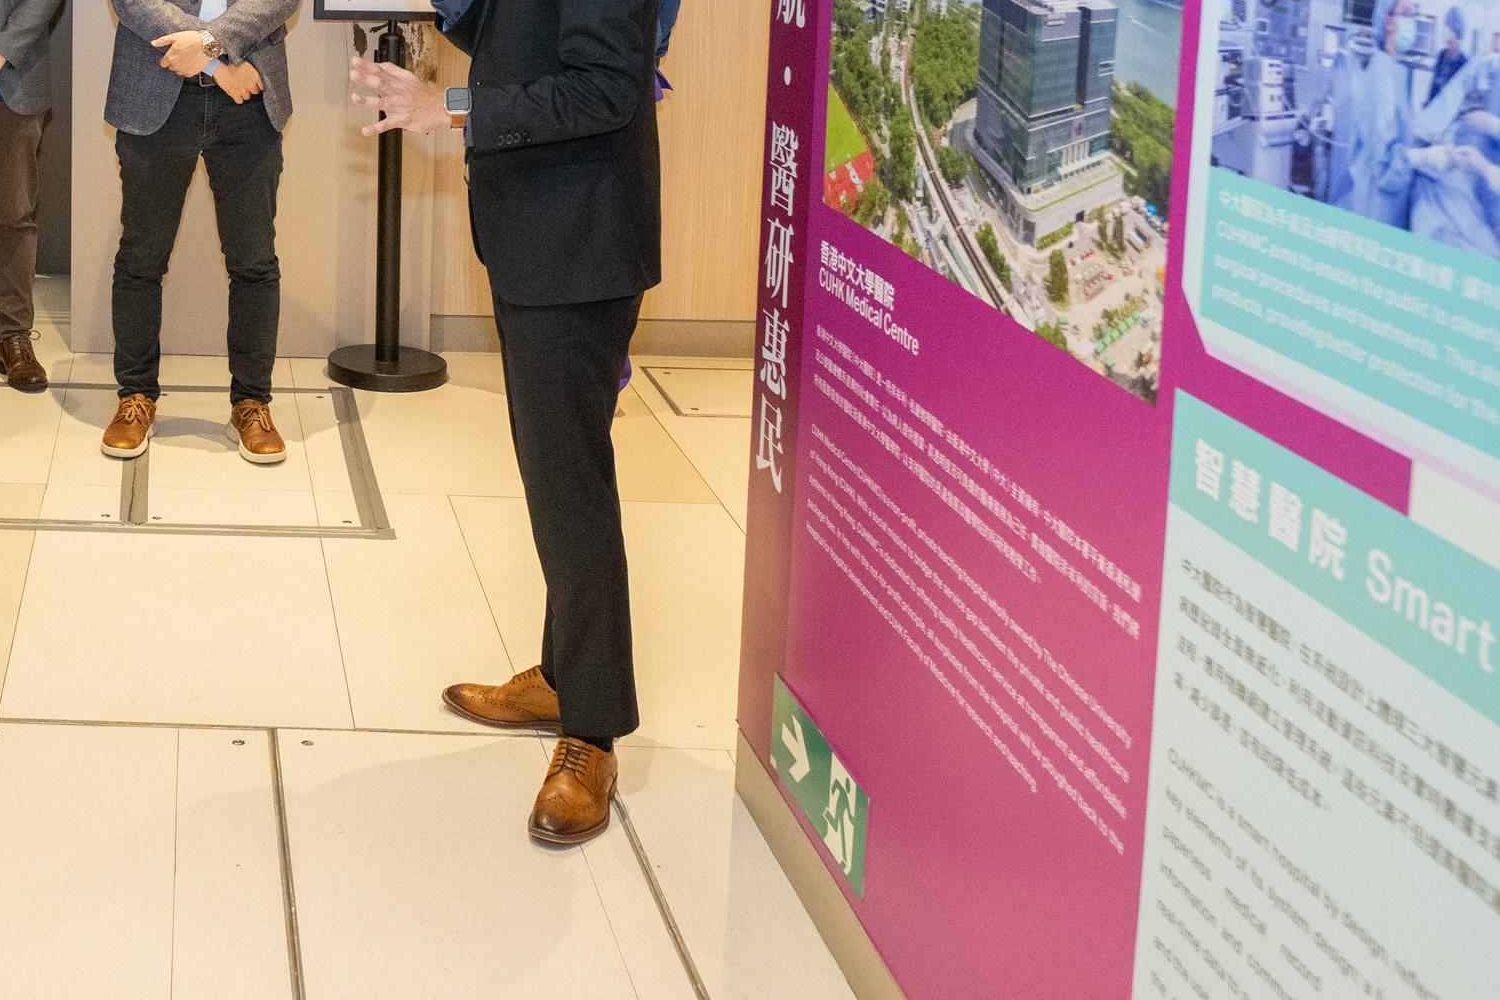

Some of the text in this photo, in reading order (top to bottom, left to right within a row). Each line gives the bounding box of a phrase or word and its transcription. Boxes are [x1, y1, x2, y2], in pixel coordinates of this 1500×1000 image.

[819, 240, 895, 311] 香港中文大學醫院
[819, 268, 920, 356] CUHK Medical Centre
[1195, 437, 1348, 580] 智慧醫院
[1365, 548, 1498, 674] Smart
[932, 571, 942, 592] the
[1006, 647, 1018, 671] the
[1044, 689, 1059, 713] and
[1042, 647, 1057, 675] The
[1057, 662, 1089, 707] Chinese
[1090, 694, 1133, 754] University
[1067, 749, 1083, 774] and
[1108, 828, 1124, 859] the
